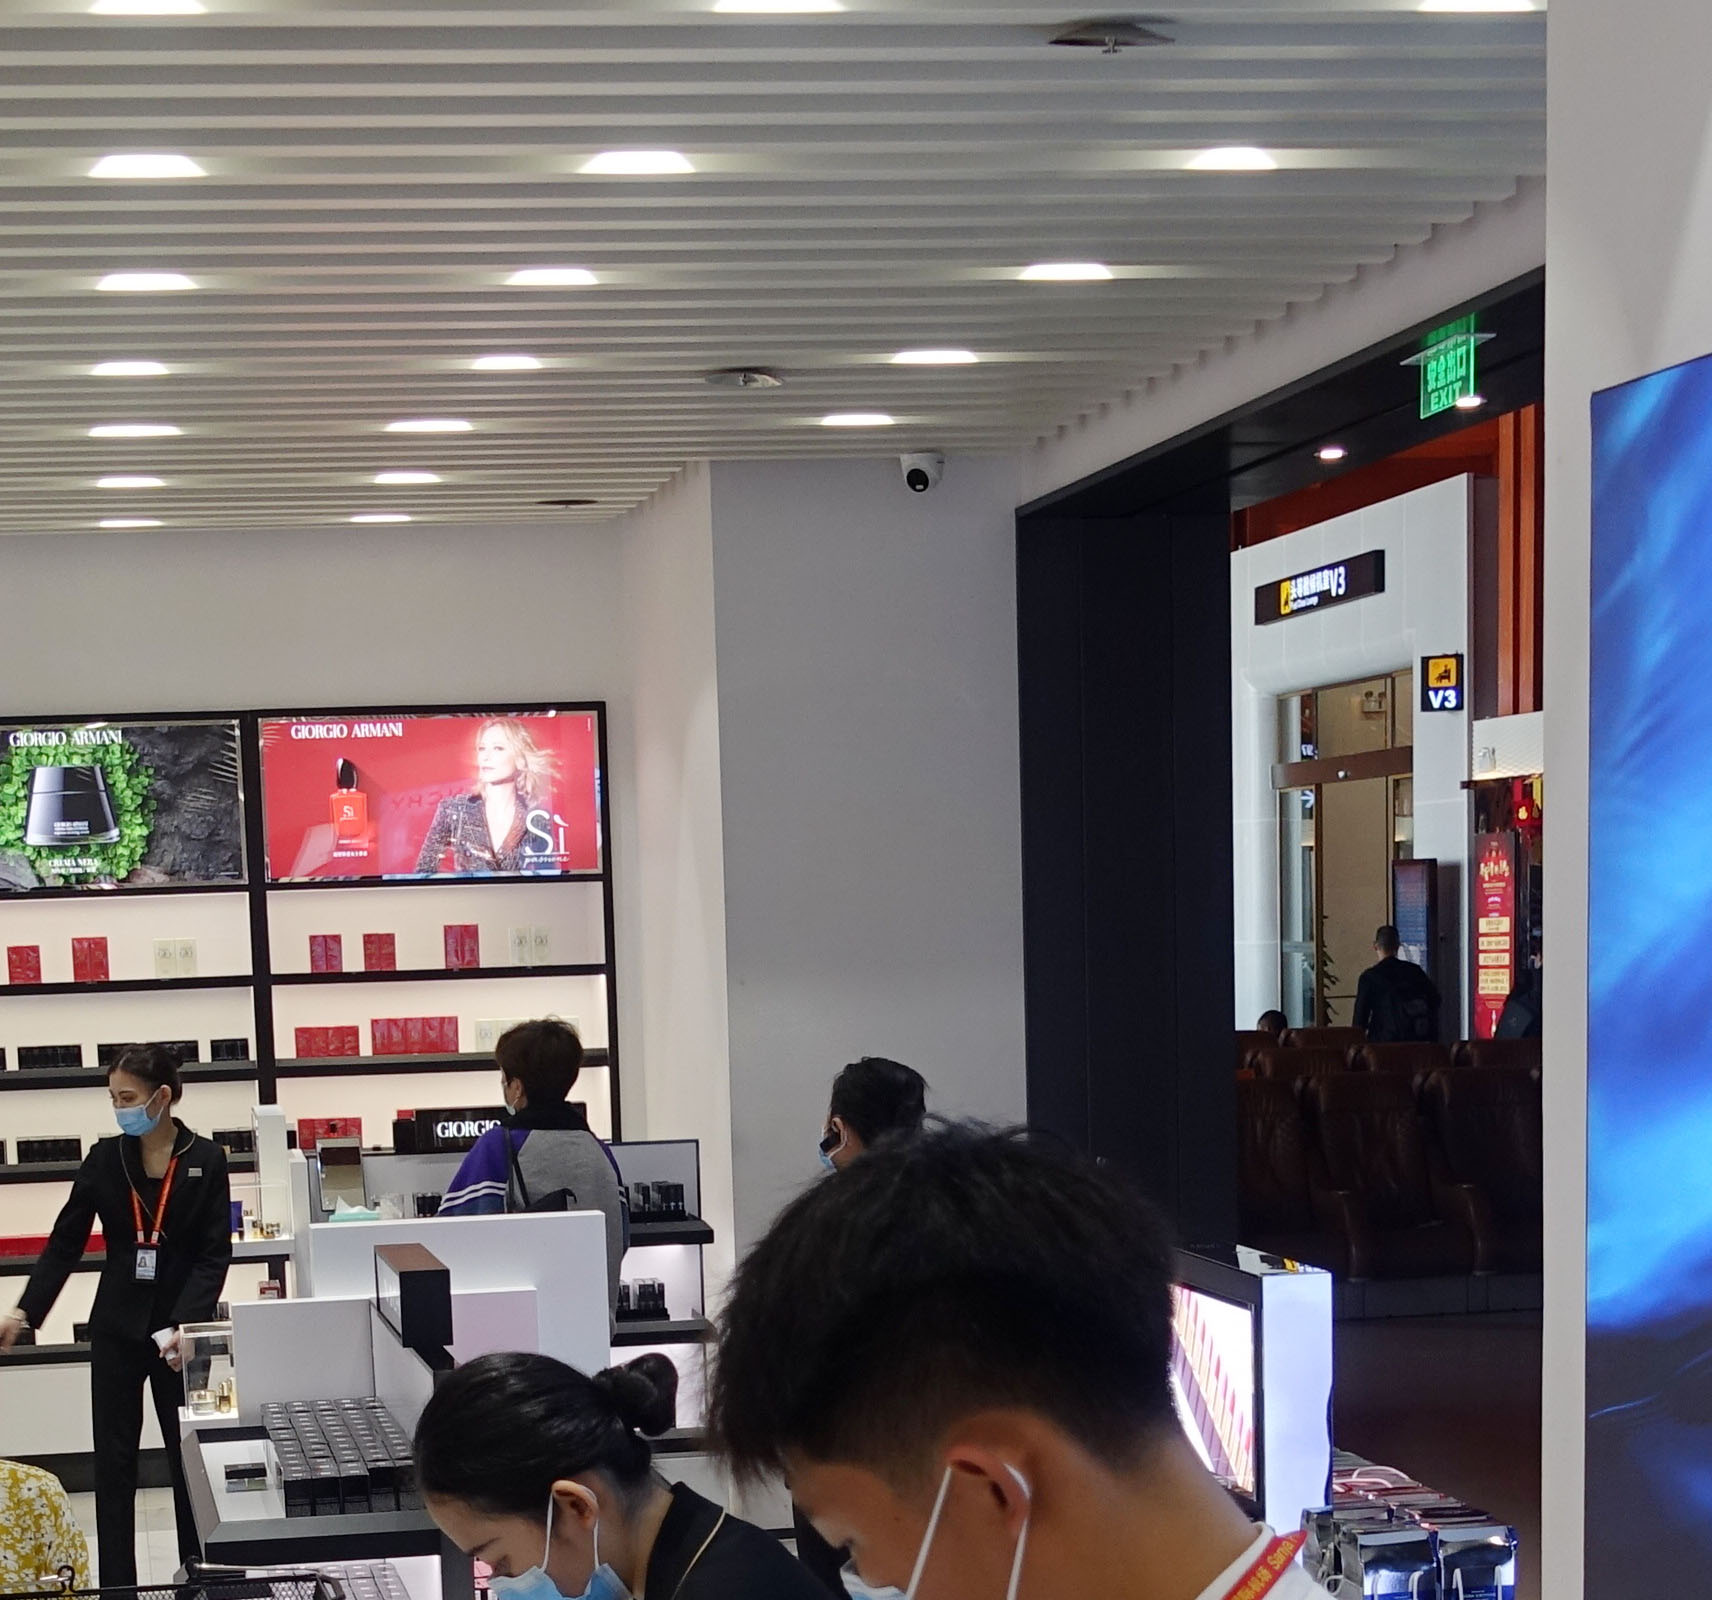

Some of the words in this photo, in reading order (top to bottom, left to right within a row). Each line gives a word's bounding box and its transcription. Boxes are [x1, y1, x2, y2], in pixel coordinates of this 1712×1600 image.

[1427, 344, 1466, 393] 安全出口
[1431, 380, 1462, 412] EXIT
[1329, 566, 1346, 597] V3
[1428, 690, 1457, 708] V3
[9, 731, 66, 747] GIORGIO
[71, 730, 122, 745] ARMANI
[291, 722, 348, 739] GIORGIO
[352, 722, 403, 738] ARMANI
[525, 810, 570, 856] Sì
